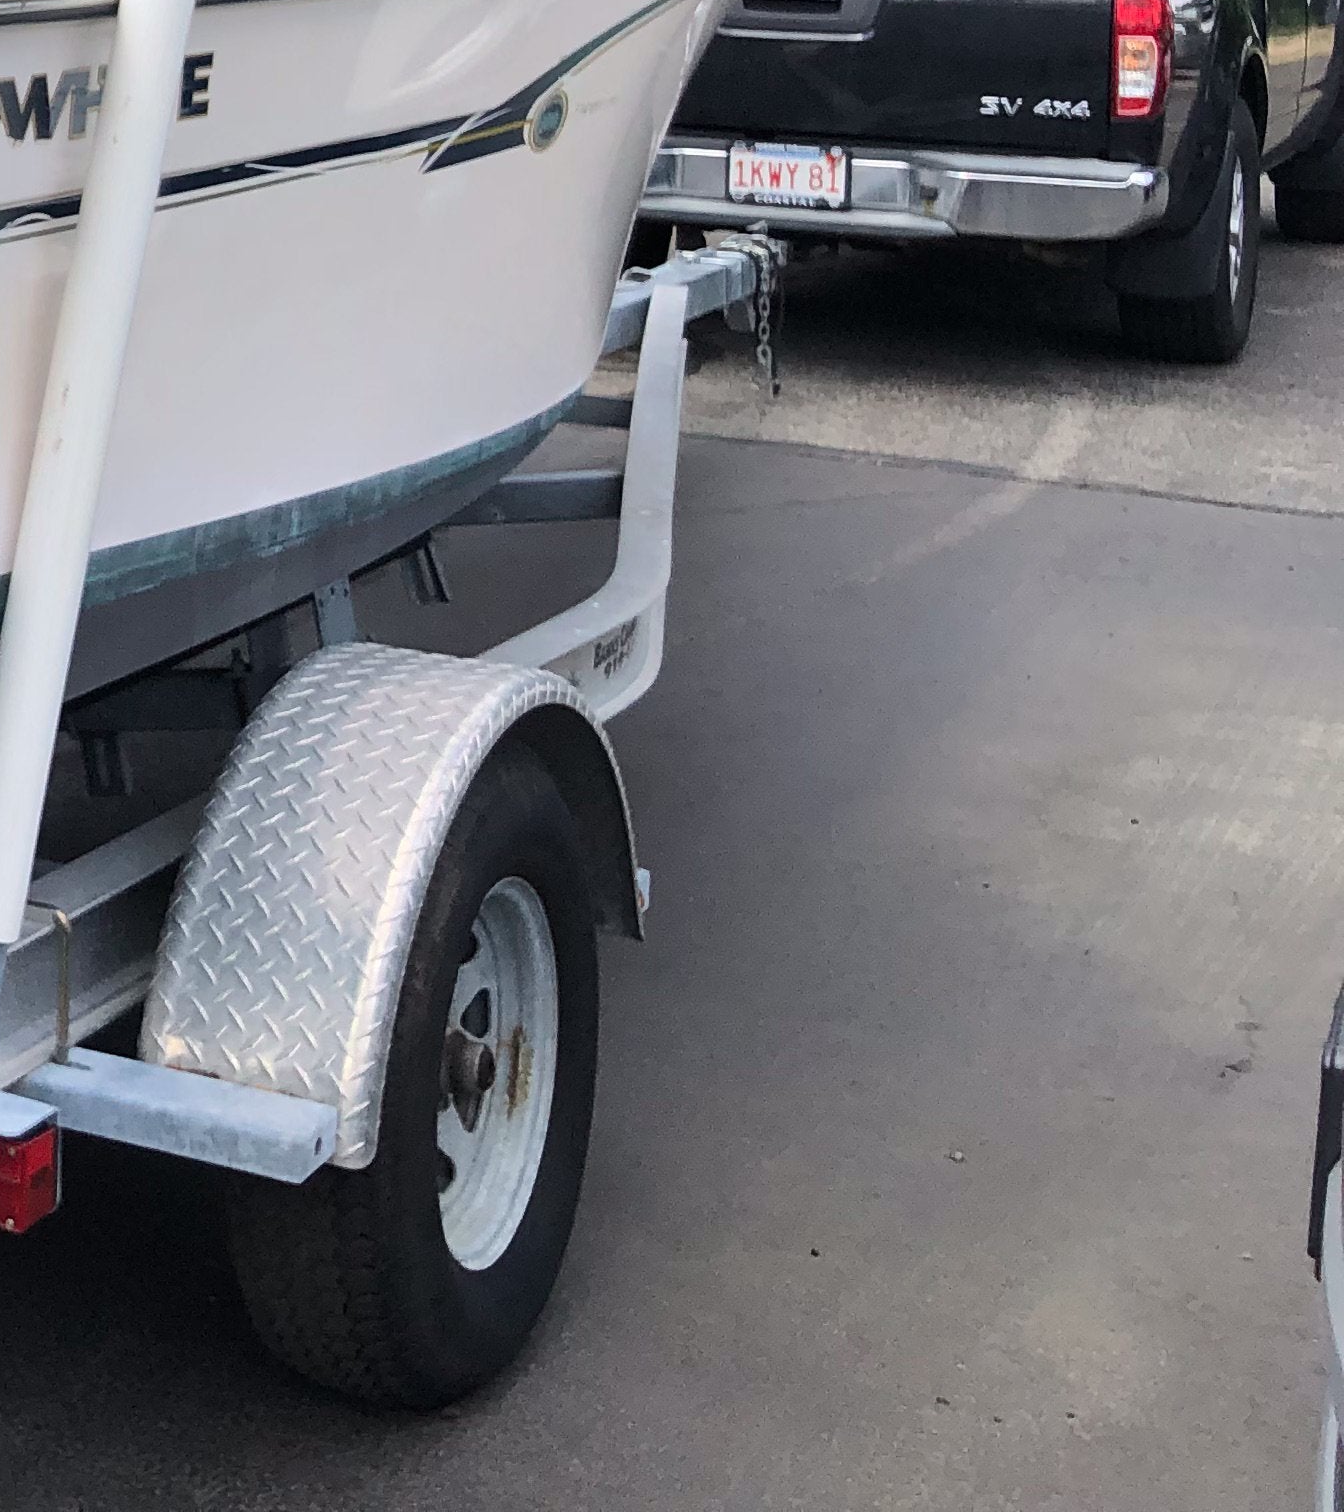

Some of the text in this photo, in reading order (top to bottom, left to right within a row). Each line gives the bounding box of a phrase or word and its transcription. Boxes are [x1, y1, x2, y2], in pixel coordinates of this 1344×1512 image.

[978, 95, 1023, 117] SV
[734, 158, 839, 194] 1KWY 81
